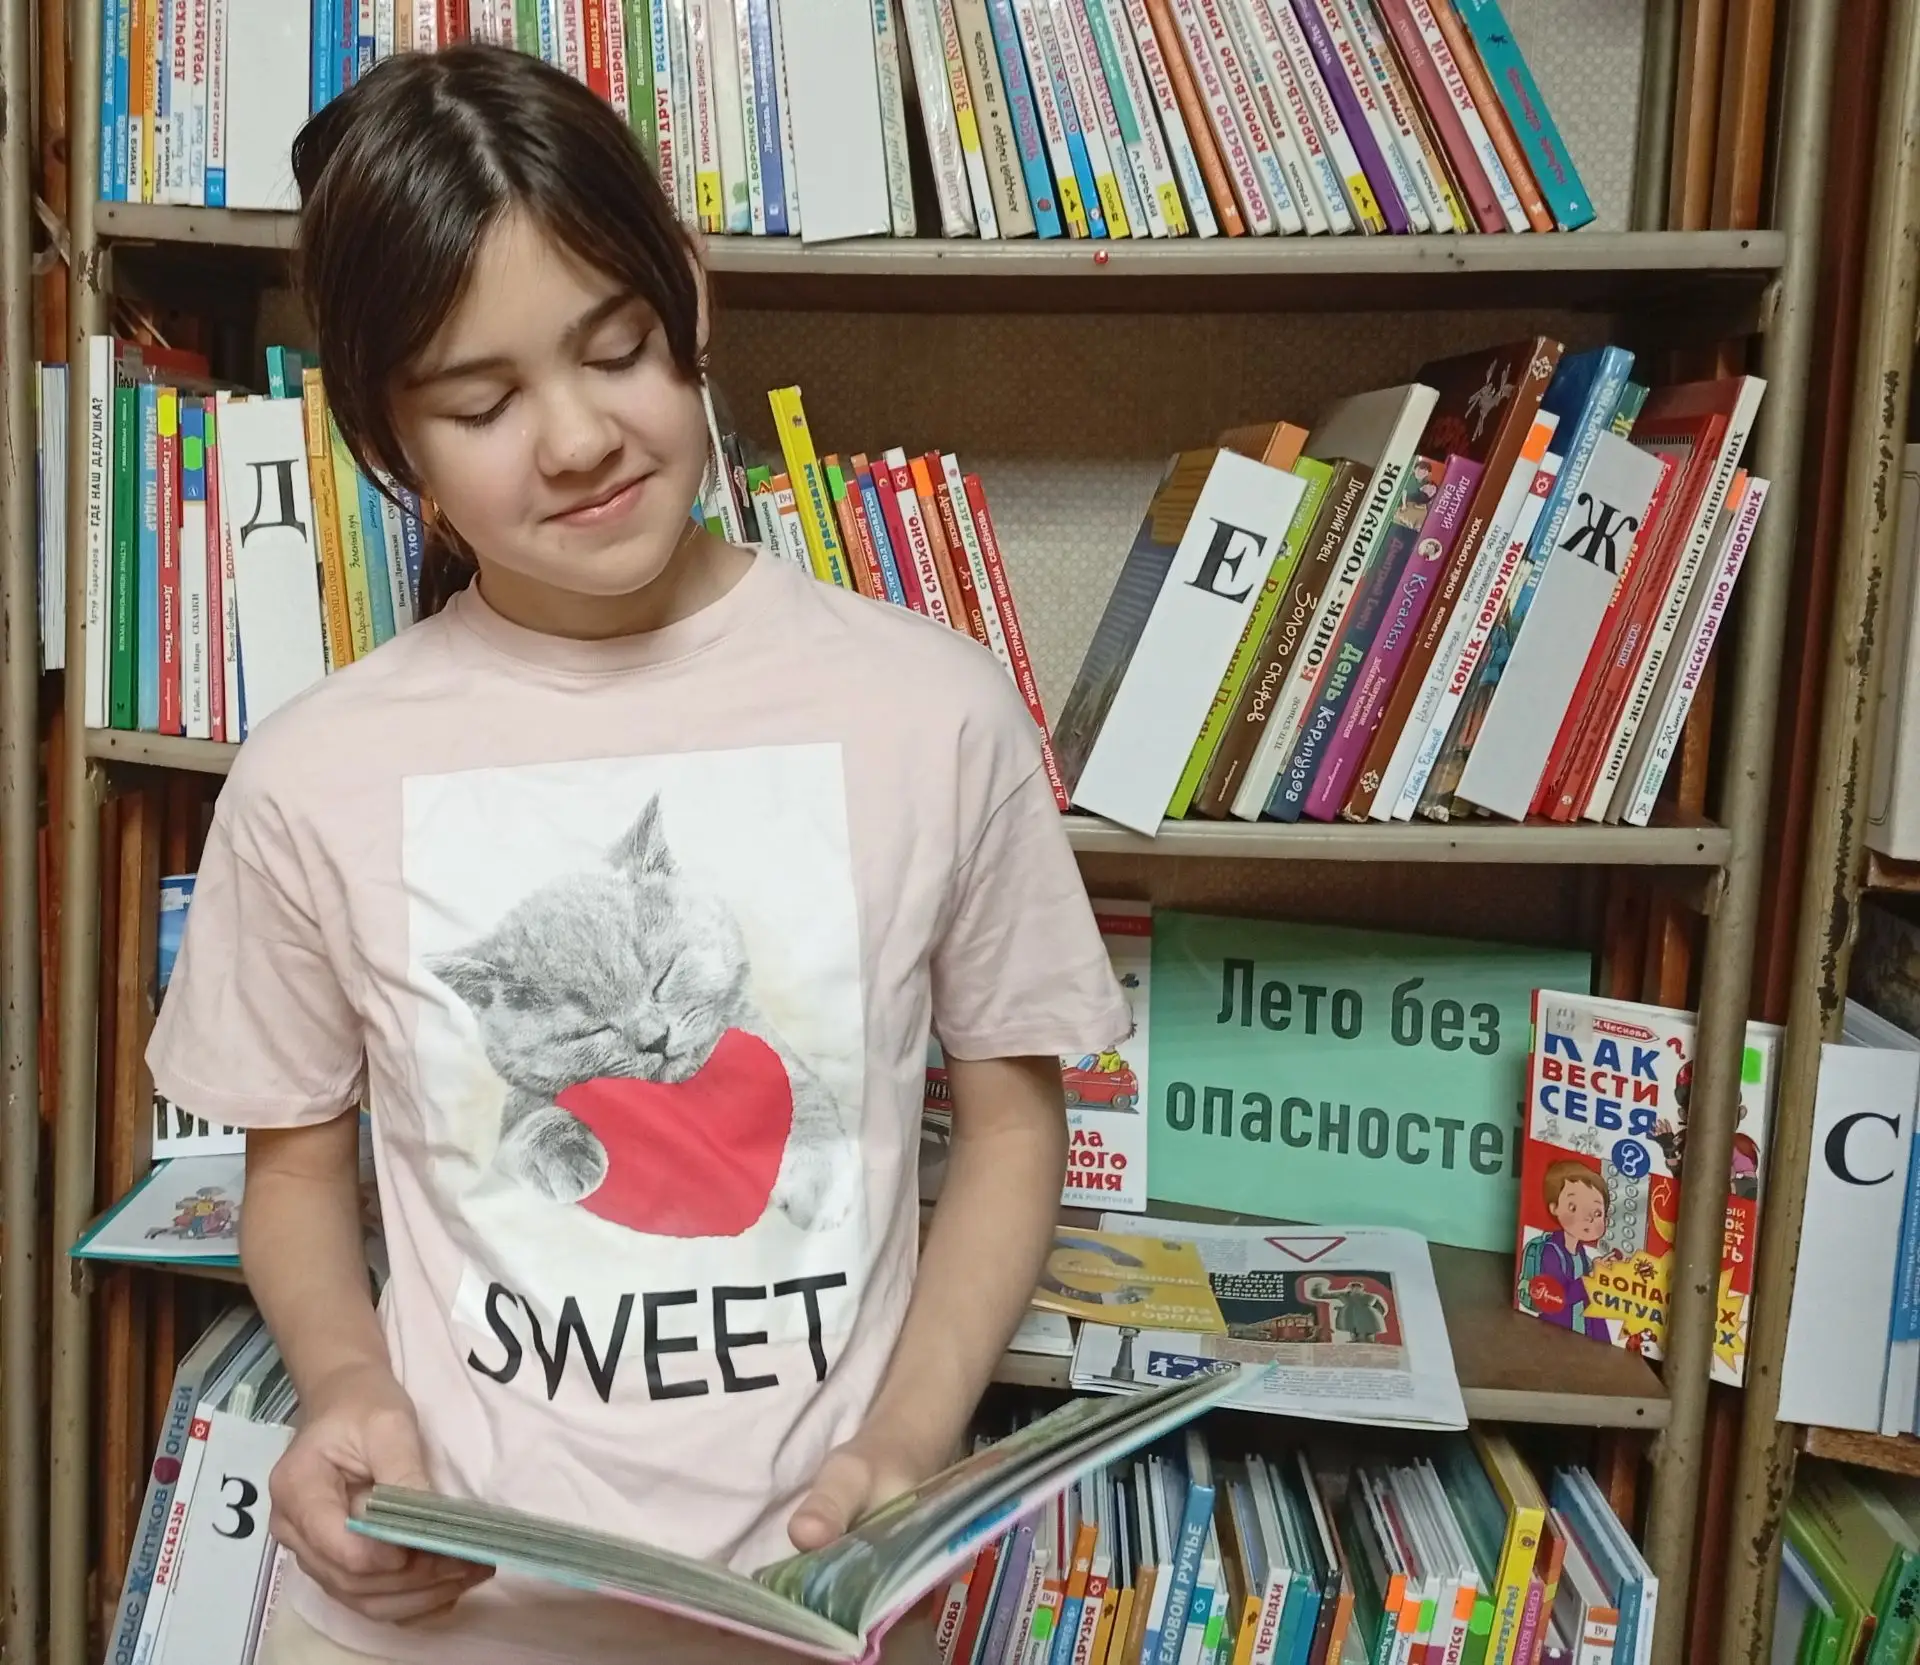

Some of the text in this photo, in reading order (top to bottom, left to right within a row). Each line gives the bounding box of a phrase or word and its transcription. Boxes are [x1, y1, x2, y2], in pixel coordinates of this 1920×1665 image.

[586, 7, 604, 68] ИСТОРИИ
[1073, 76, 1095, 133] КОМАНДА
[1092, 73, 1117, 126] СТРАНЕ
[1139, 37, 1174, 114] МЯГКИЙ
[1219, 45, 1268, 156] КОРОЛЕВСТВО
[1271, 48, 1322, 157] КОРОЛЕВСТВО
[1298, 57, 1314, 78] ЕГО
[1308, 78, 1339, 136] КОМАНДА
[1336, 39, 1377, 114] МЯГКИЙ
[1381, 83, 1407, 127] СТРАНЕ
[1430, 39, 1474, 113] МЯГКИЙ
[656, 88, 672, 133] ДРУГ
[697, 89, 711, 163] ЭЛЕКТРОНИКА
[1037, 84, 1062, 143] АСФАЛЬТЕ
[990, 124, 1010, 162] ГАЙДАР
[1216, 105, 1267, 224] КОРОЛЕВСТВО
[999, 163, 1021, 213] АРКАДИЙ
[89, 398, 104, 467] ДЕДУШКА?
[89, 504, 100, 526] ГДЕ
[91, 472, 100, 499] НАШ
[162, 438, 172, 568] Г. Гарин-Михайловский
[241, 459, 307, 548] Д
[802, 462, 837, 550] рассказы
[951, 485, 969, 522] ДЕТЕЙ
[1434, 481, 1456, 515] ЕМЕЦ
[1439, 473, 1471, 531] ДМИТРИЙ
[855, 517, 877, 567] Драгунский
[863, 490, 896, 588] лет под кроватью
[936, 493, 965, 548] Драгунский
[963, 524, 977, 550] ДЛЯ
[1315, 475, 1365, 565] Дмитрий Емец
[1538, 506, 1566, 556] ЕРШОВ
[1558, 492, 1638, 575] Ж
[1661, 429, 1744, 633] РАССКАЗЫ О ЖИВОТНЫХ
[970, 552, 987, 590] СТИХИ
[991, 565, 1007, 597] ИВАНА
[1183, 517, 1268, 604] Е
[1681, 488, 1765, 690] РАССКАЗЫ ПРО ЖИВОТНЫХ
[163, 584, 172, 662] Детство Темы
[1001, 600, 1024, 657] СТРАДАНИЯ
[1381, 570, 1428, 655] Кусалки
[1018, 660, 1026, 668] И
[1244, 581, 1314, 725] Золото скифов
[1324, 641, 1361, 704] День
[1021, 670, 1037, 705] ЖИЗНЬ
[1605, 727, 1633, 782] БОРИС
[1627, 648, 1662, 722] ЖИТКОВ
[1415, 726, 1445, 767] Ершов
[1659, 694, 1691, 744] Житков
[1054, 788, 1064, 800] Л.
[1216, 958, 1501, 1055] Лето без
[1542, 1057, 1659, 1107] ВЕСТИ
[1544, 1033, 1659, 1082] КАК
[1540, 1085, 1658, 1141] СЕБЯ
[1825, 1112, 1901, 1186] С
[467, 1271, 848, 1403] SWEET
[127, 1486, 167, 1595] Житков
[163, 1384, 191, 1454] ОГНЕЙ
[211, 1472, 259, 1539] З
[1175, 1523, 1204, 1584] РУЧЬЕ
[1255, 1582, 1283, 1656] ЧЕРЕПАХИ
